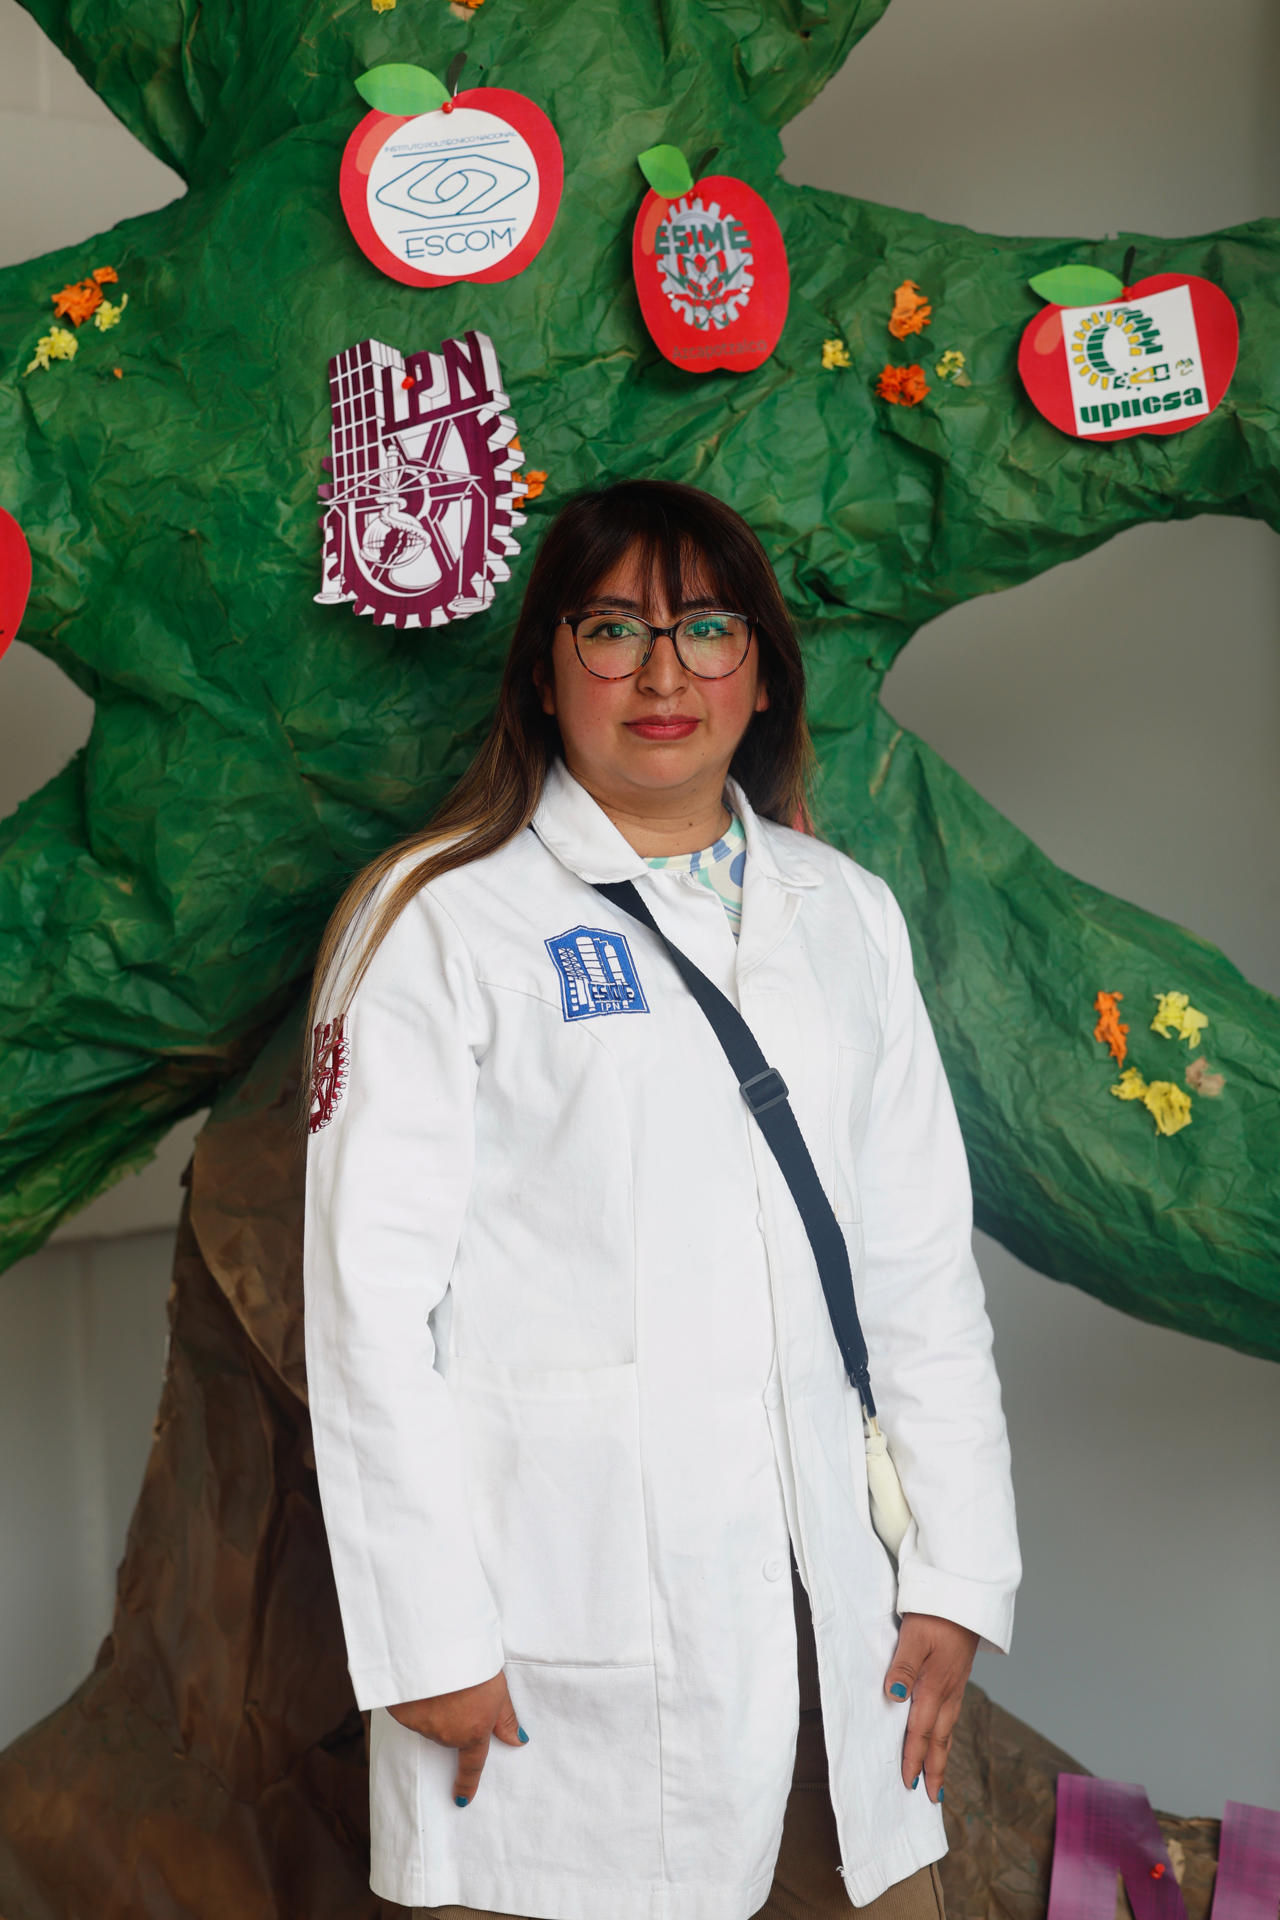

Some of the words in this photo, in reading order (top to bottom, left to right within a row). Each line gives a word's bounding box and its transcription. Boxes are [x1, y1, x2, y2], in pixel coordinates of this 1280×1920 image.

[406, 227, 512, 258] ESCOM
[655, 221, 752, 255] ESIME
[381, 331, 498, 428] IPN
[601, 1002, 620, 1011] IPN
